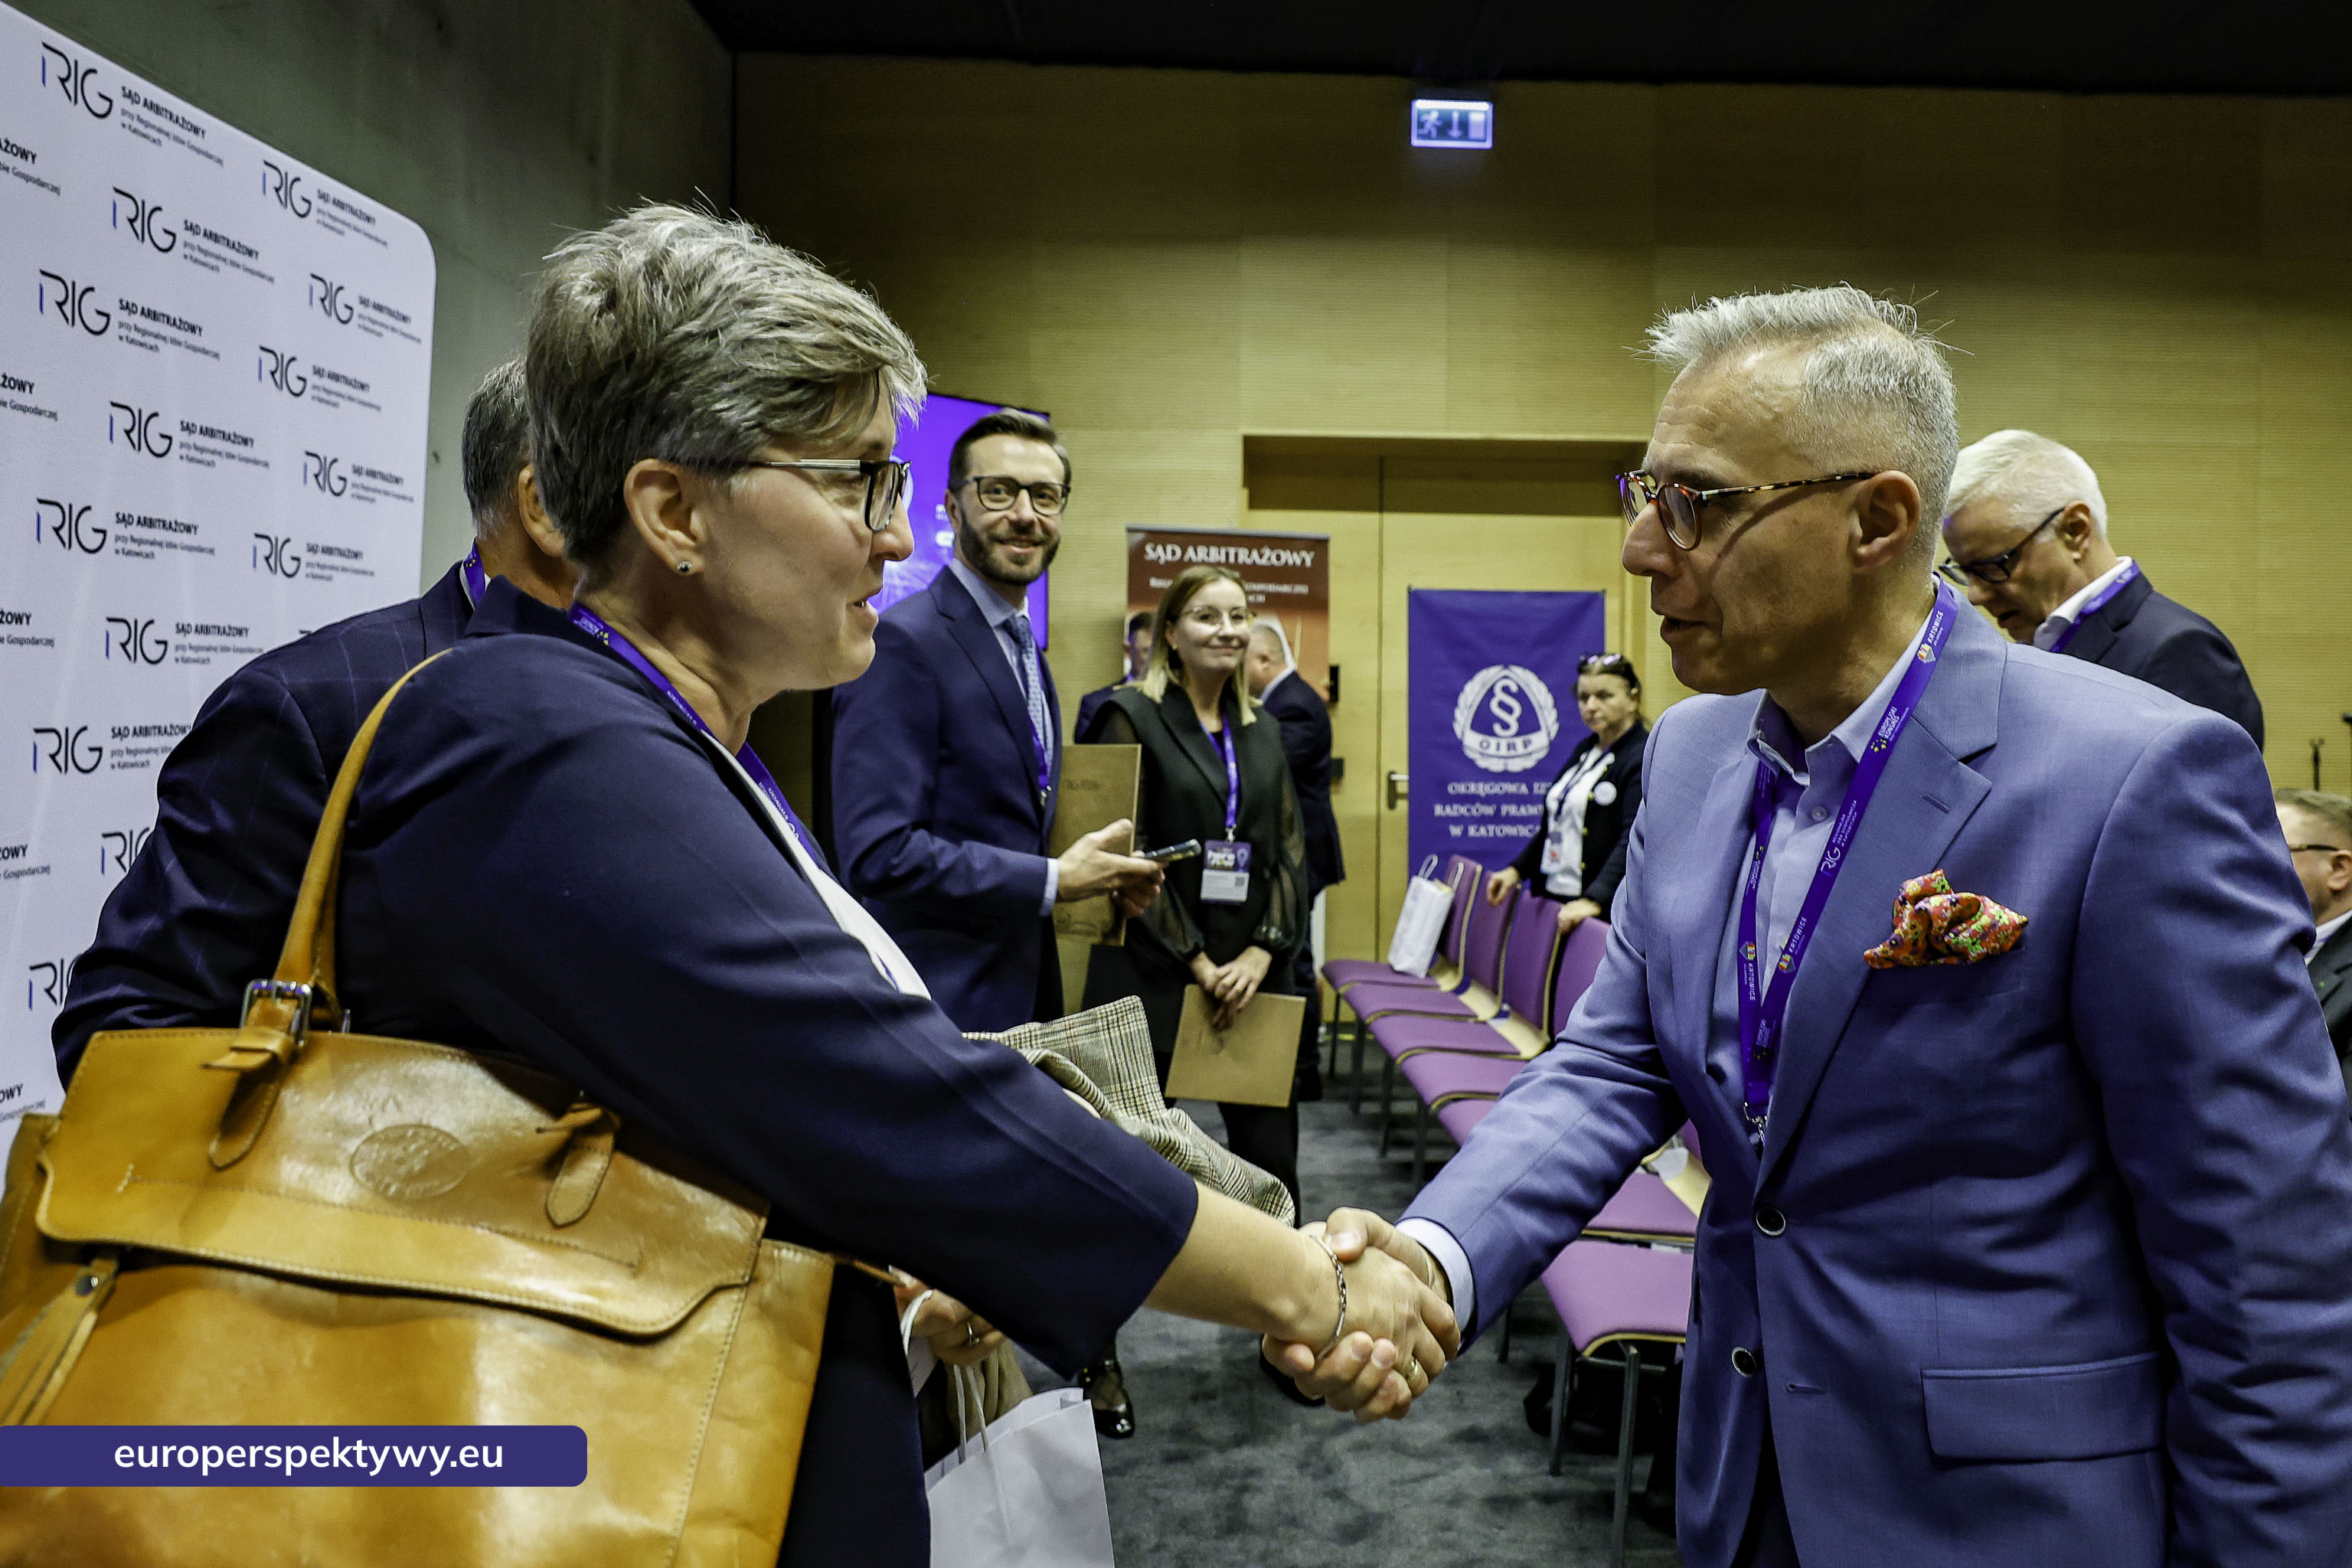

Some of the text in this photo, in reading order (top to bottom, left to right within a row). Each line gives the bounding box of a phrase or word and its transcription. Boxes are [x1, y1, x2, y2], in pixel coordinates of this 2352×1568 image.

[41, 40, 113, 119] RIG
[122, 85, 207, 139] SĄD ARBITRAŻOWY
[263, 158, 312, 218] RIG
[113, 185, 176, 253] RIG
[184, 218, 260, 260] SĄD ARBITRAŻOWY
[39, 269, 112, 336] RIG
[119, 297, 204, 337] SĄD ARBITRAŻOWY
[309, 273, 354, 325] RIG
[258, 345, 307, 397] RIG
[109, 400, 173, 458] RIG
[180, 420, 255, 449] SĄD ARBITRAŻOWY
[303, 449, 348, 497] RIG
[36, 497, 107, 554] RIG
[115, 511, 199, 536] SĄD ARBITRAŻOWY
[253, 531, 301, 579] RIG
[1144, 541, 1315, 568] SĄD ARBITRAŻOWY
[106, 615, 168, 665] RIG
[175, 622, 250, 638] SĄD ARBITRAŻOWY
[1927, 609, 1944, 643] KATOWICE
[33, 725, 103, 775] RIG
[1449, 825, 1464, 838] W
[1820, 846, 1841, 877] RIG
[1788, 916, 1808, 953] KATOWICE
